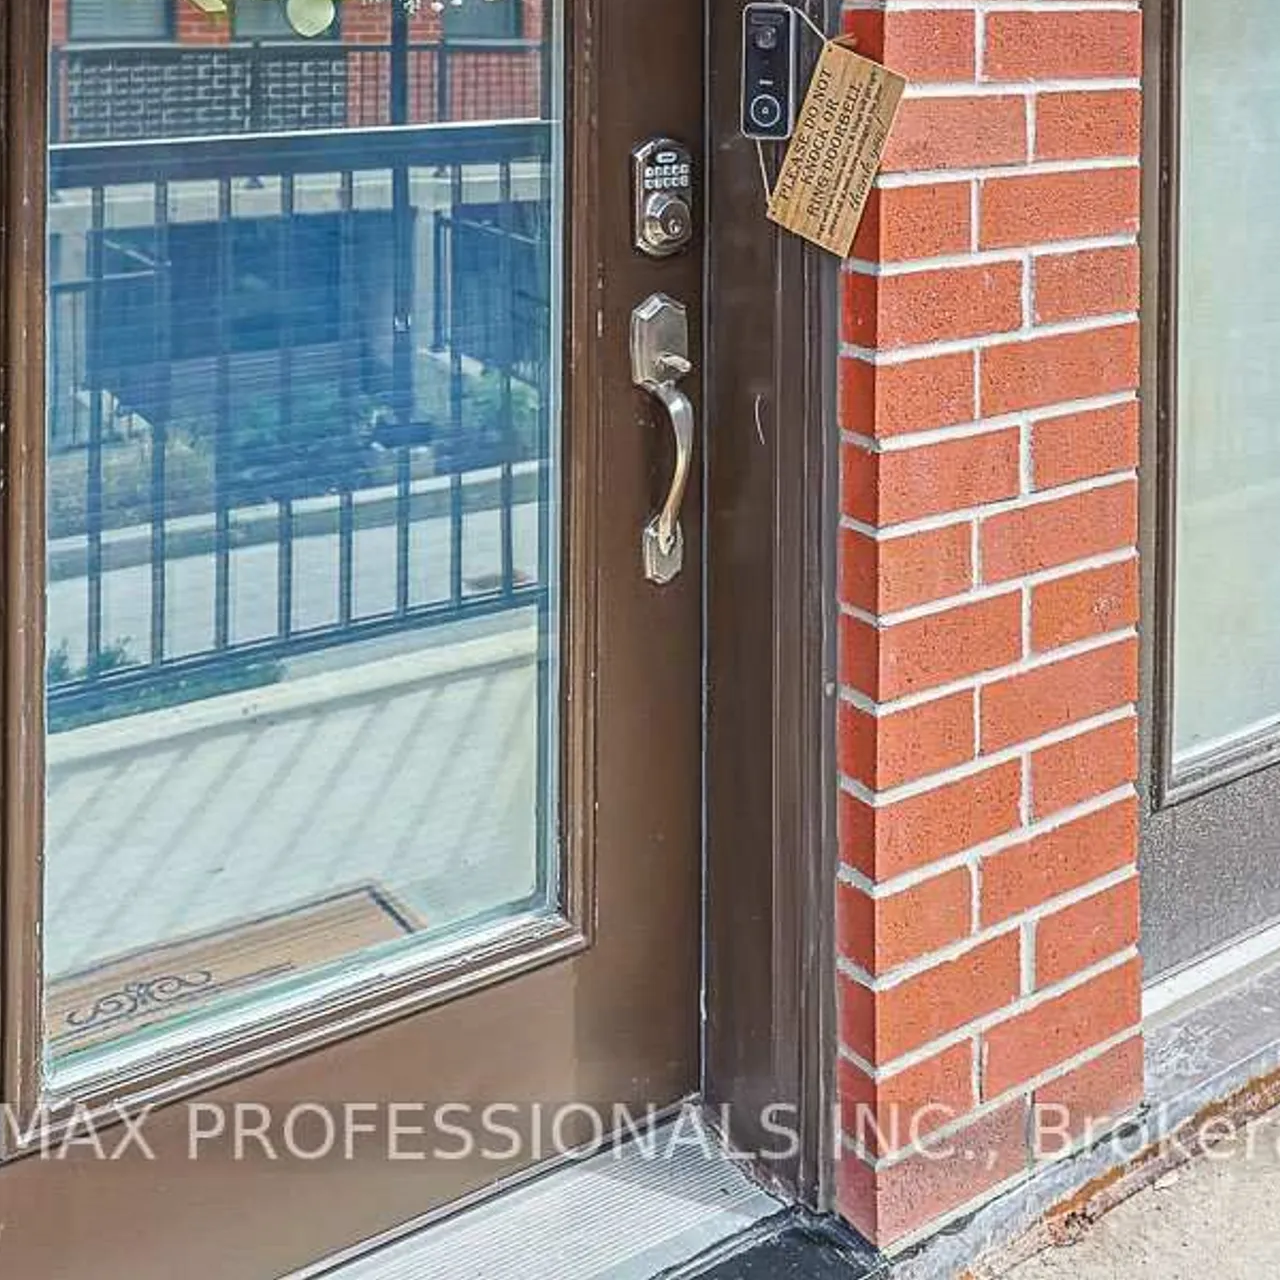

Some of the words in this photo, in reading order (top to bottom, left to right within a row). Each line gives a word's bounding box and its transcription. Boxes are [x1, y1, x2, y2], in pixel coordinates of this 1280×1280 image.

[779, 133, 809, 200] PLEASE
[804, 106, 819, 130] DO
[814, 69, 832, 103] NOT
[801, 128, 830, 186] KNOCK
[823, 99, 840, 124] OR
[806, 175, 830, 218] RING
